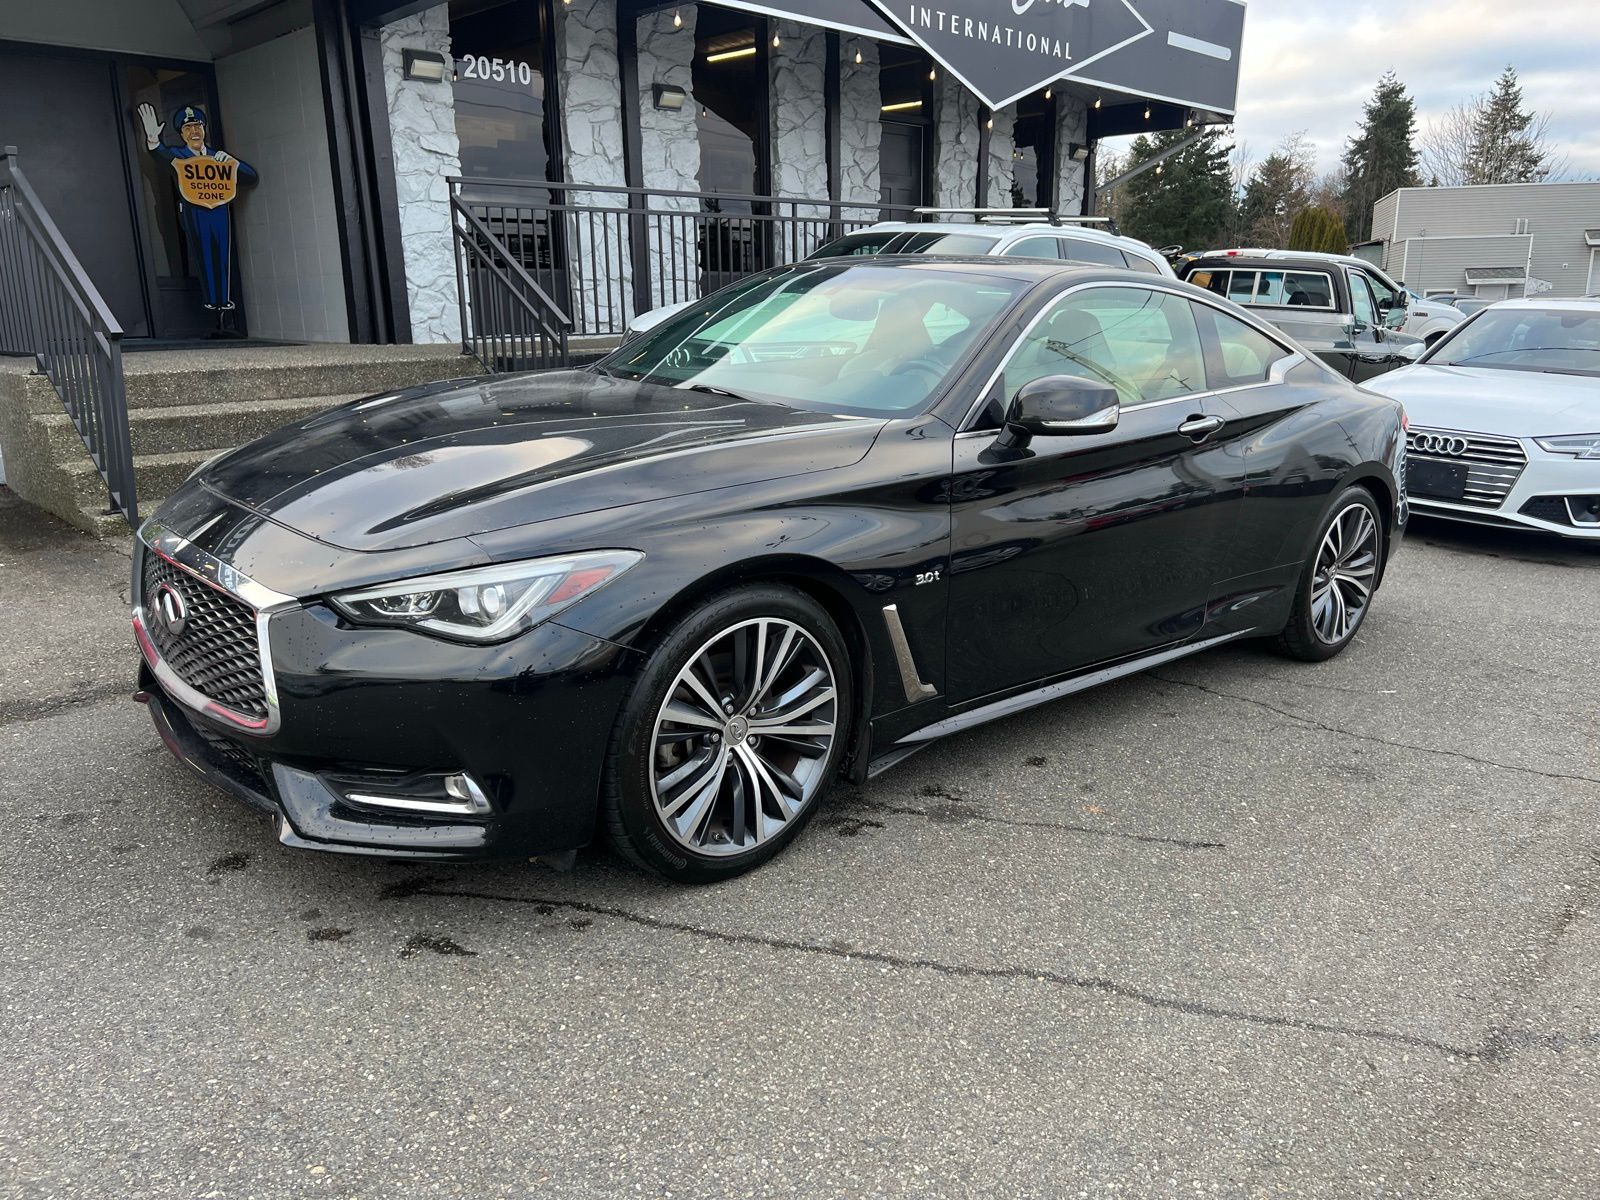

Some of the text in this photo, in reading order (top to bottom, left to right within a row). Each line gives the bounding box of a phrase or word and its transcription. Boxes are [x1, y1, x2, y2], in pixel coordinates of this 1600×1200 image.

[910, 4, 1073, 61] INTERNATIONAL
[463, 54, 531, 85] 20510
[184, 164, 232, 181] SLOW
[190, 182, 231, 191] SCHOOL
[198, 192, 225, 201] ZONE
